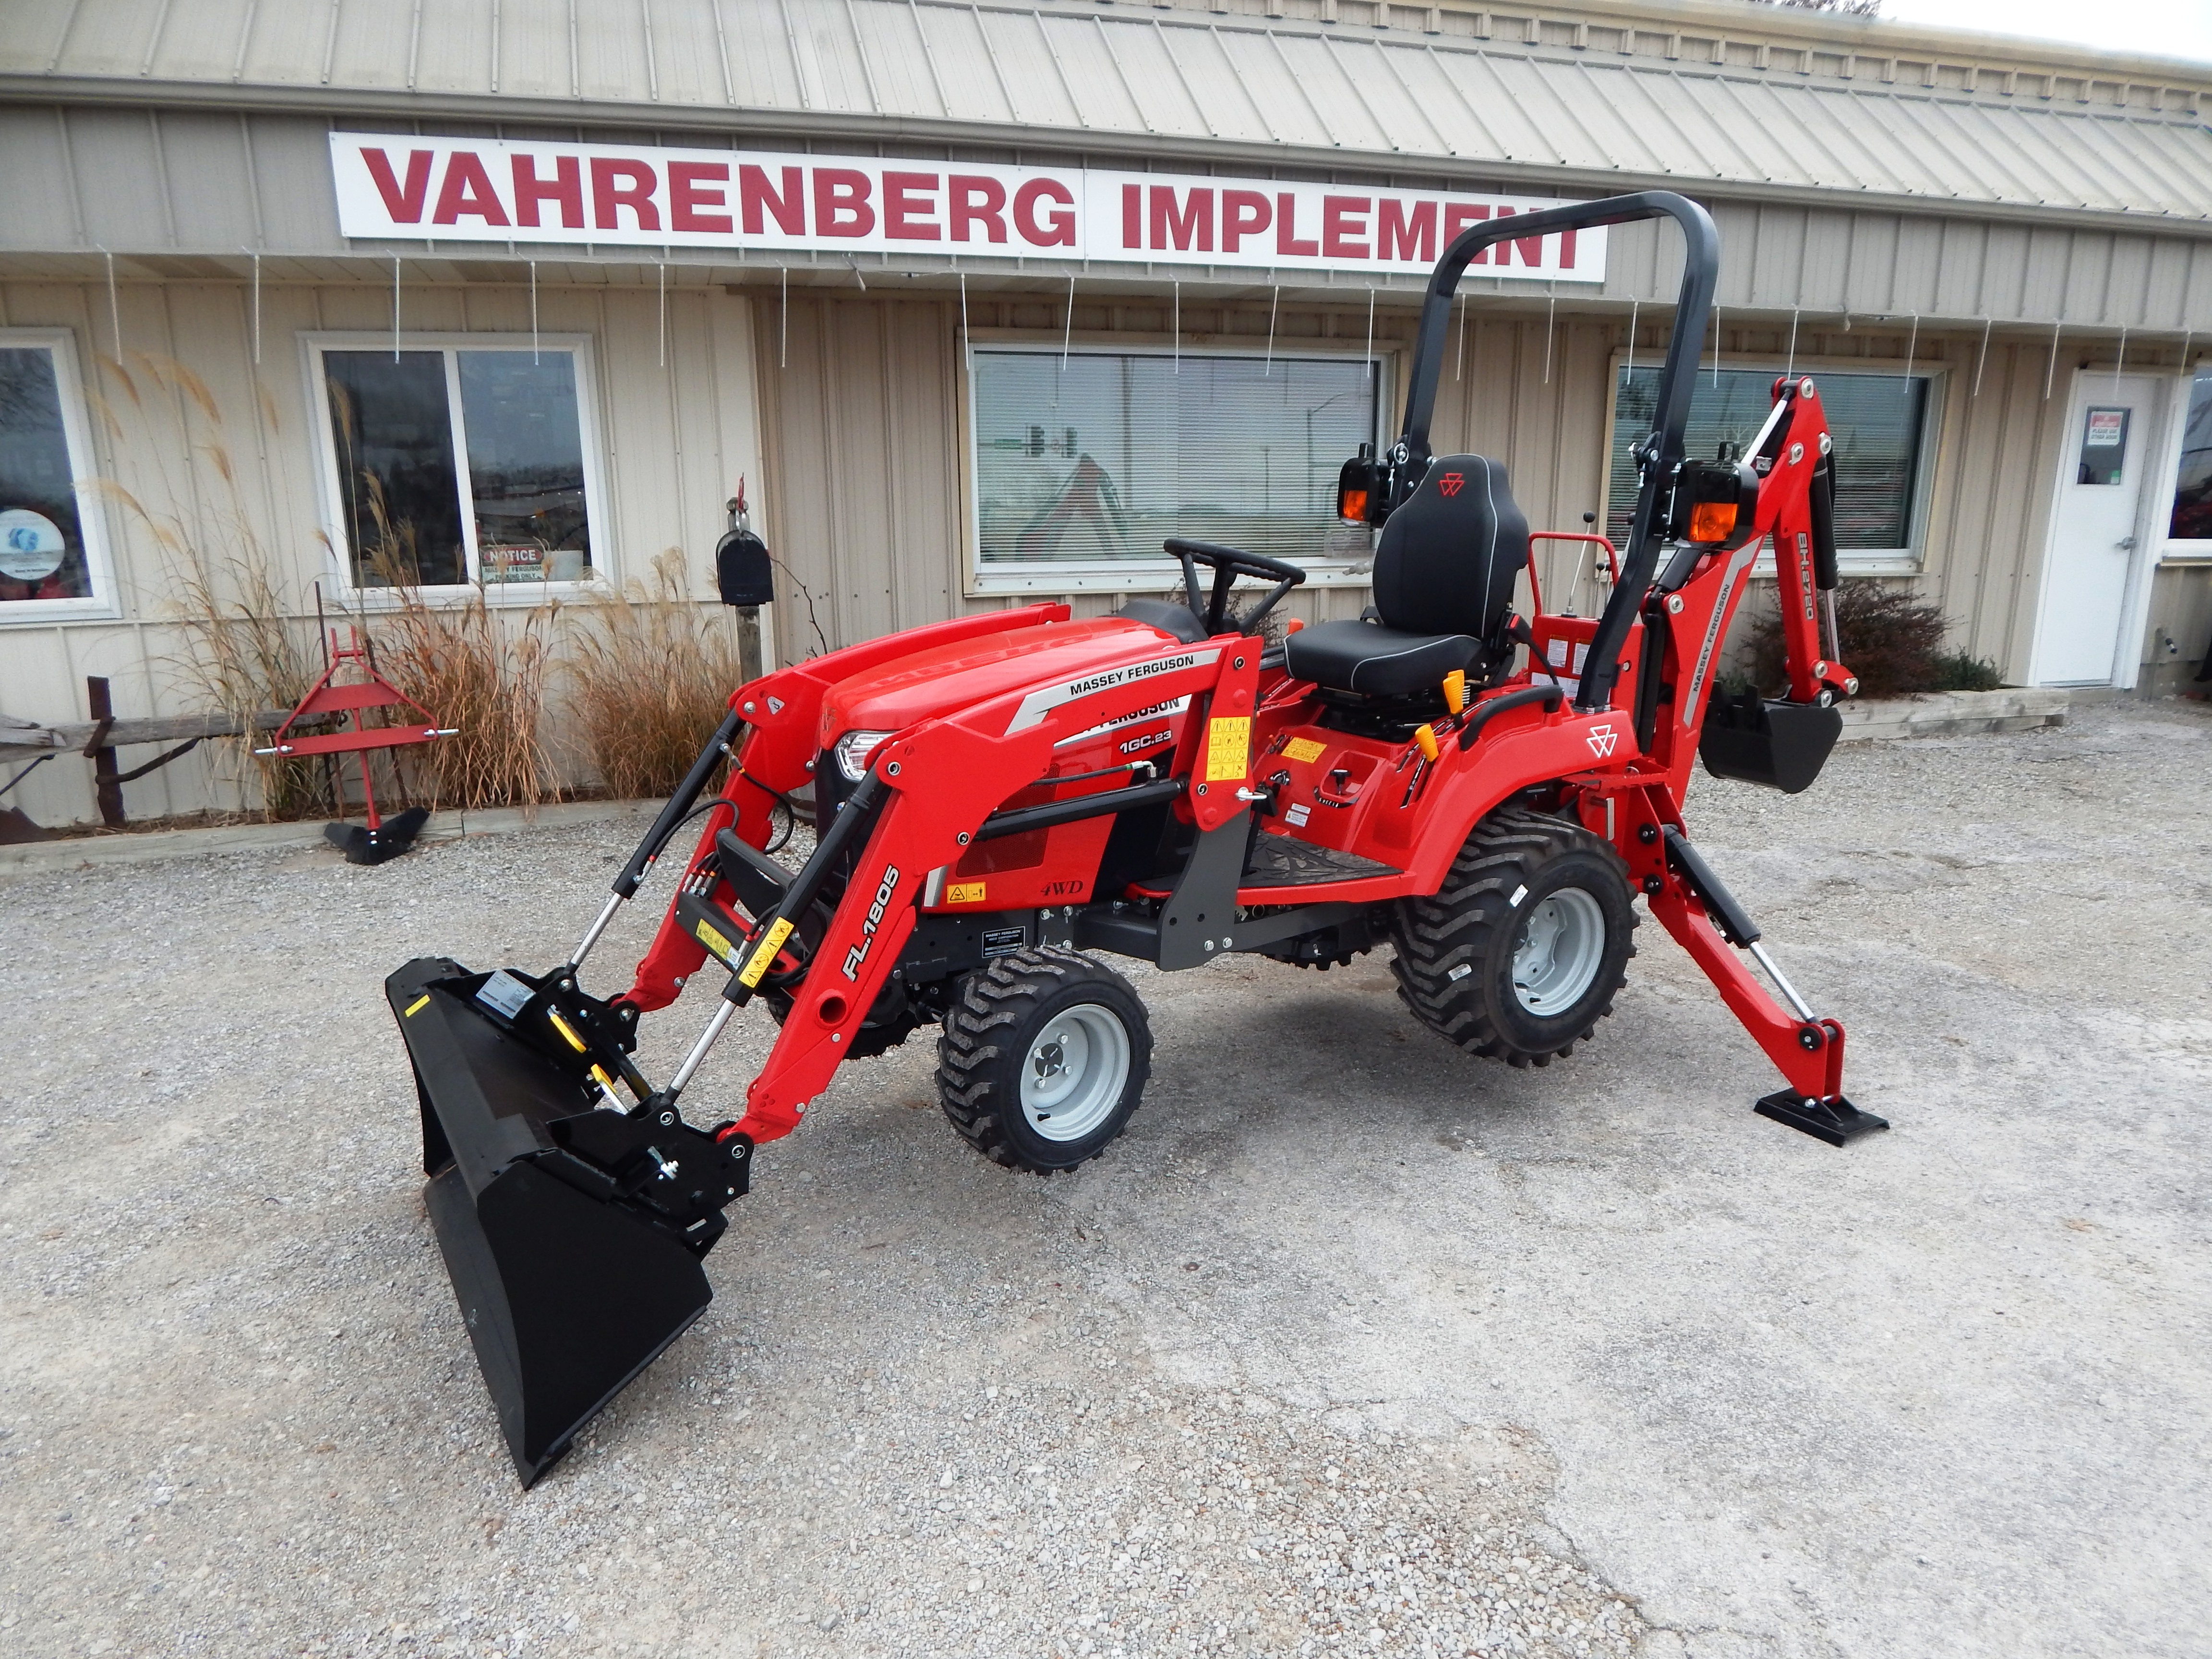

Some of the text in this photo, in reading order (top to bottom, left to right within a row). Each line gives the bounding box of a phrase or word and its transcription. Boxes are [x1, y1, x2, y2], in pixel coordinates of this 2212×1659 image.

[359, 147, 1076, 248] VAHRENBERG
[490, 549, 536, 561] NOTICE
[1693, 584, 1730, 692] MASSEY FERGUSON
[1070, 655, 1194, 696] MASSEY FERGUSON
[1119, 730, 1172, 754] 1GC.23
[1040, 880, 1083, 896] 4WD
[842, 864, 900, 982] FL.1805
